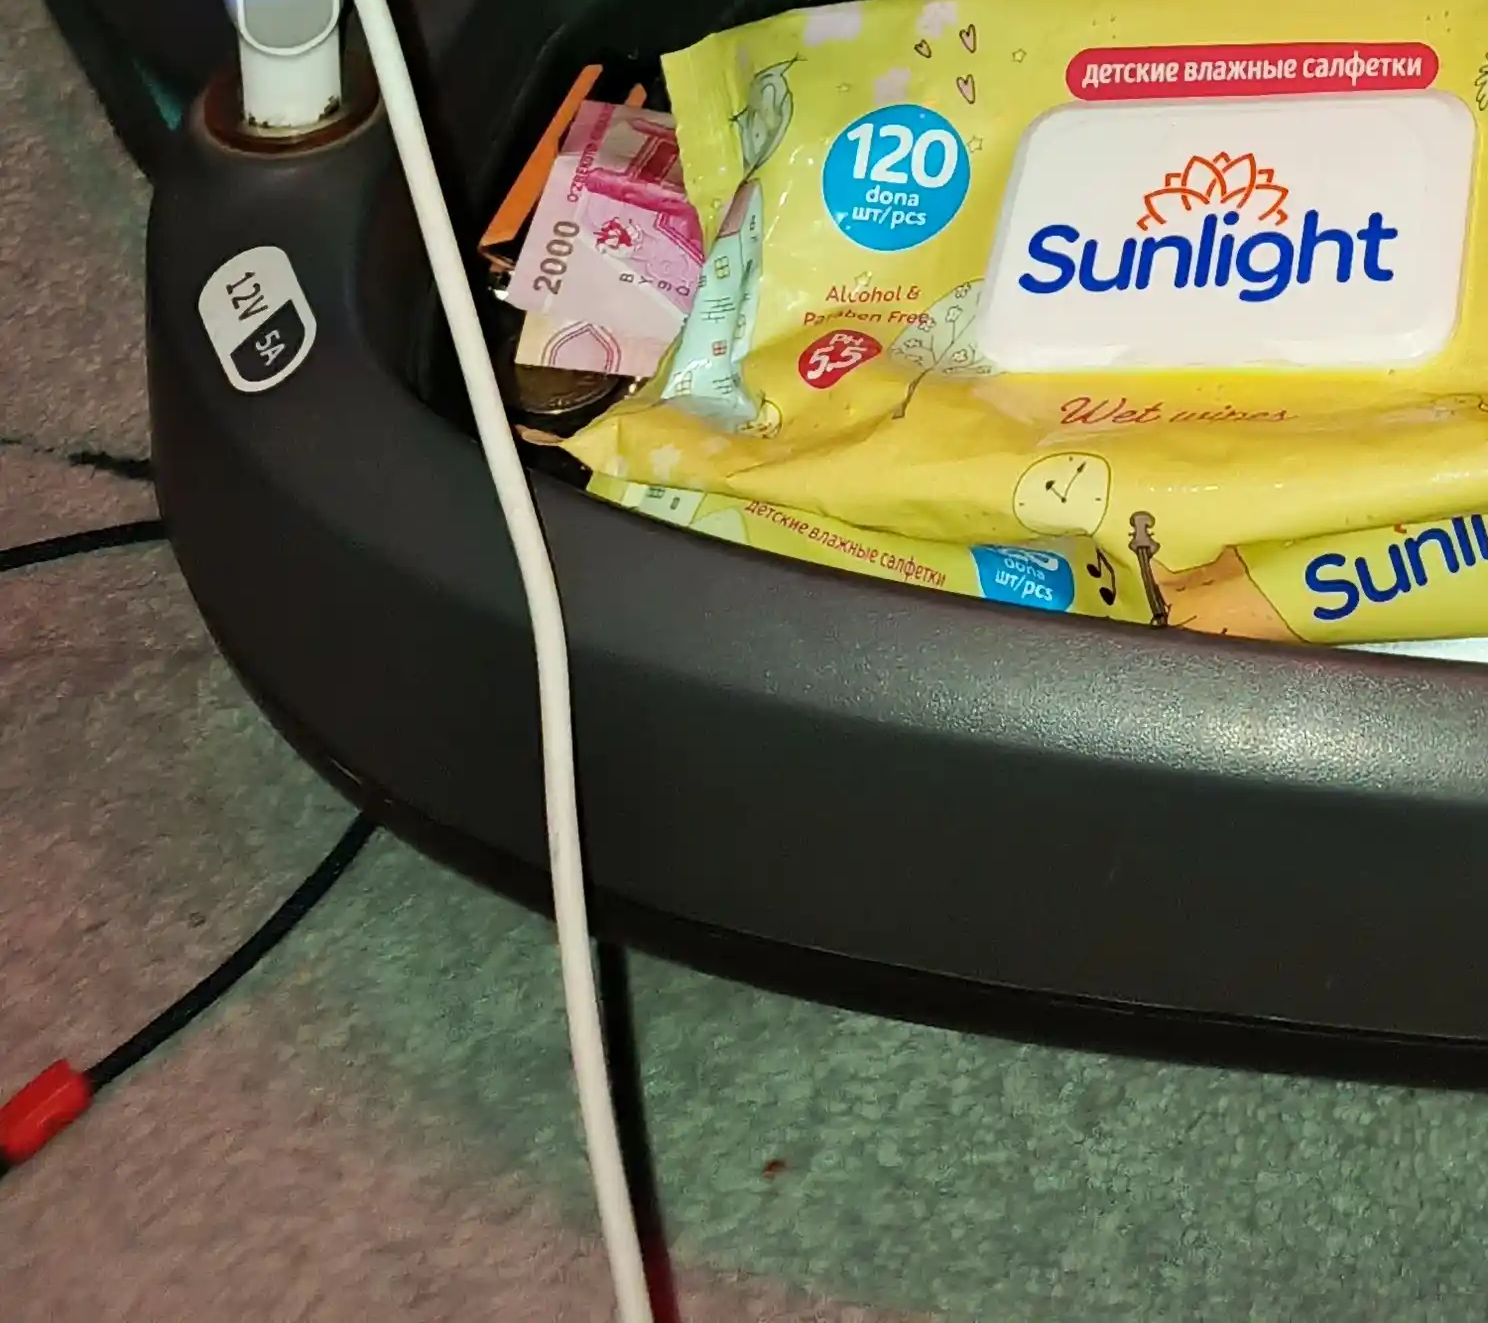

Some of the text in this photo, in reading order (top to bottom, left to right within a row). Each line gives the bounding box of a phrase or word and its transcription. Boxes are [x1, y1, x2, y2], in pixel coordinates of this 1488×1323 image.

[1081, 50, 1423, 89] детские влажные салфетки
[846, 122, 959, 189] 120
[865, 185, 920, 207] dona
[533, 220, 580, 295] 2000
[1018, 208, 1399, 303] Sunlight
[225, 271, 269, 322] 12V
[825, 285, 921, 304] Alcohol &
[887, 310, 930, 326] Free
[255, 329, 286, 367] 5A
[806, 345, 867, 381] 5.5
[1060, 397, 1164, 425] Wet
[808, 527, 879, 565] влажные
[879, 553, 947, 589] салфетки
